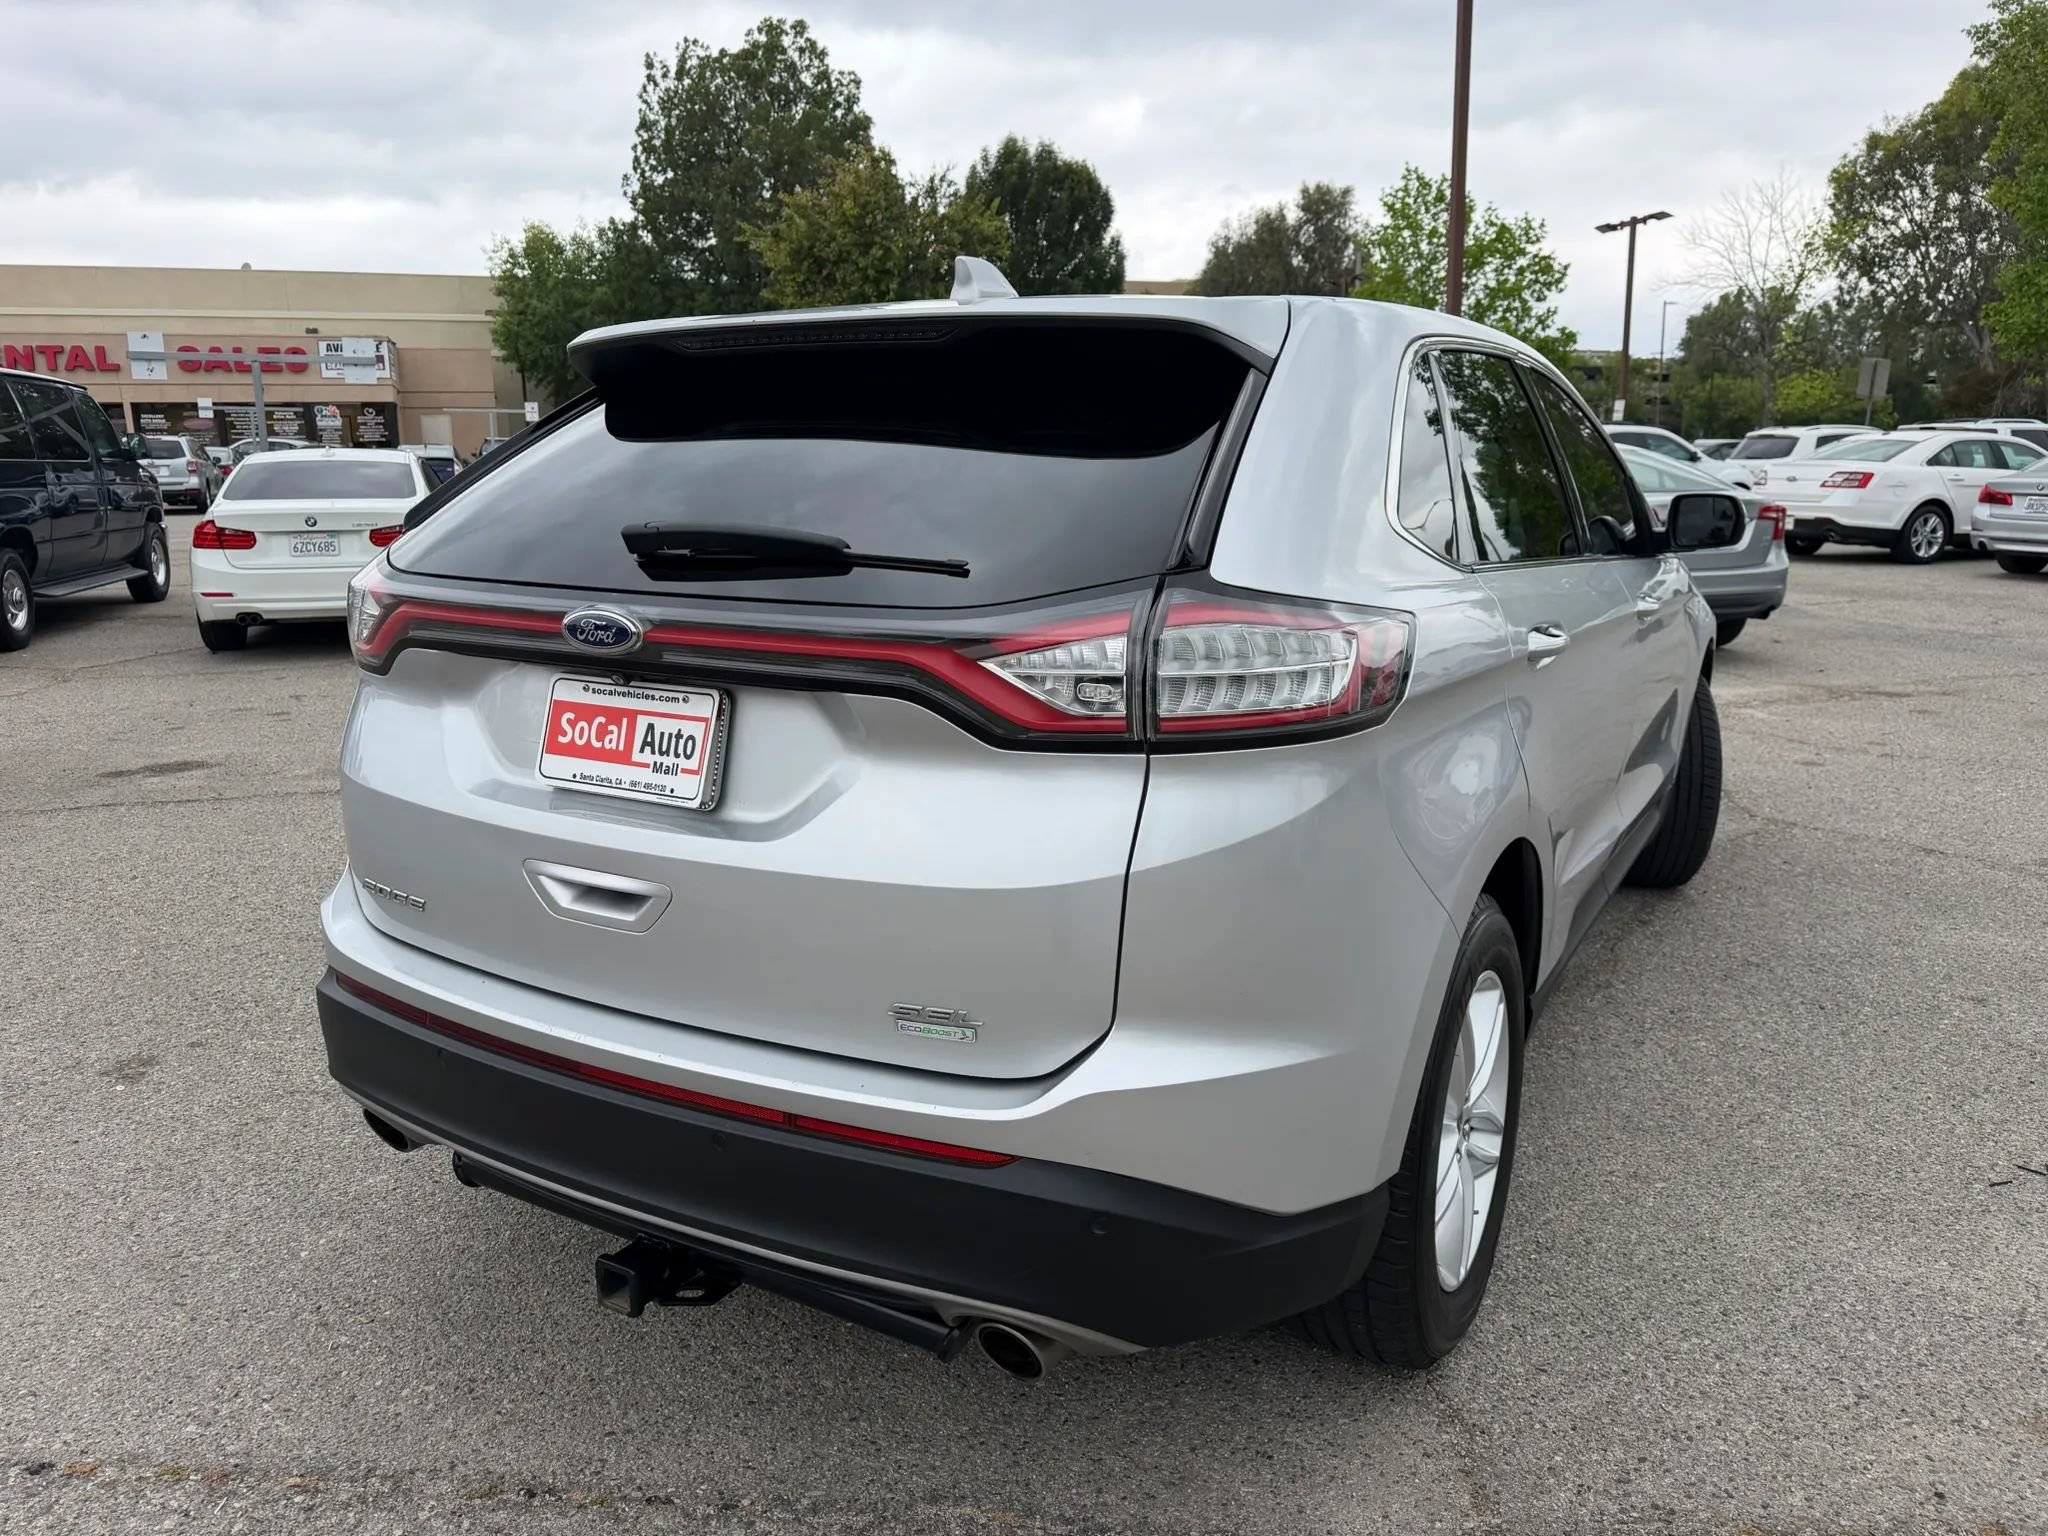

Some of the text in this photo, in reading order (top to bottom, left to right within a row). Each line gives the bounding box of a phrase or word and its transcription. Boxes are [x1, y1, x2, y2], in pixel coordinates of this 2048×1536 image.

[0, 344, 121, 372] NTAL
[176, 345, 309, 373] SALES
[292, 541, 337, 554] 6ZCY685
[576, 618, 617, 645] Ford
[591, 685, 681, 705] socalvehicles.com
[557, 711, 629, 752] SoCal
[638, 721, 697, 761] Auto
[579, 772, 595, 781] Santa
[614, 778, 623, 786] CA
[628, 779, 642, 790] (661)
[651, 761, 680, 777] Mall
[363, 877, 426, 912] EDGE
[887, 1002, 984, 1026] SEL
